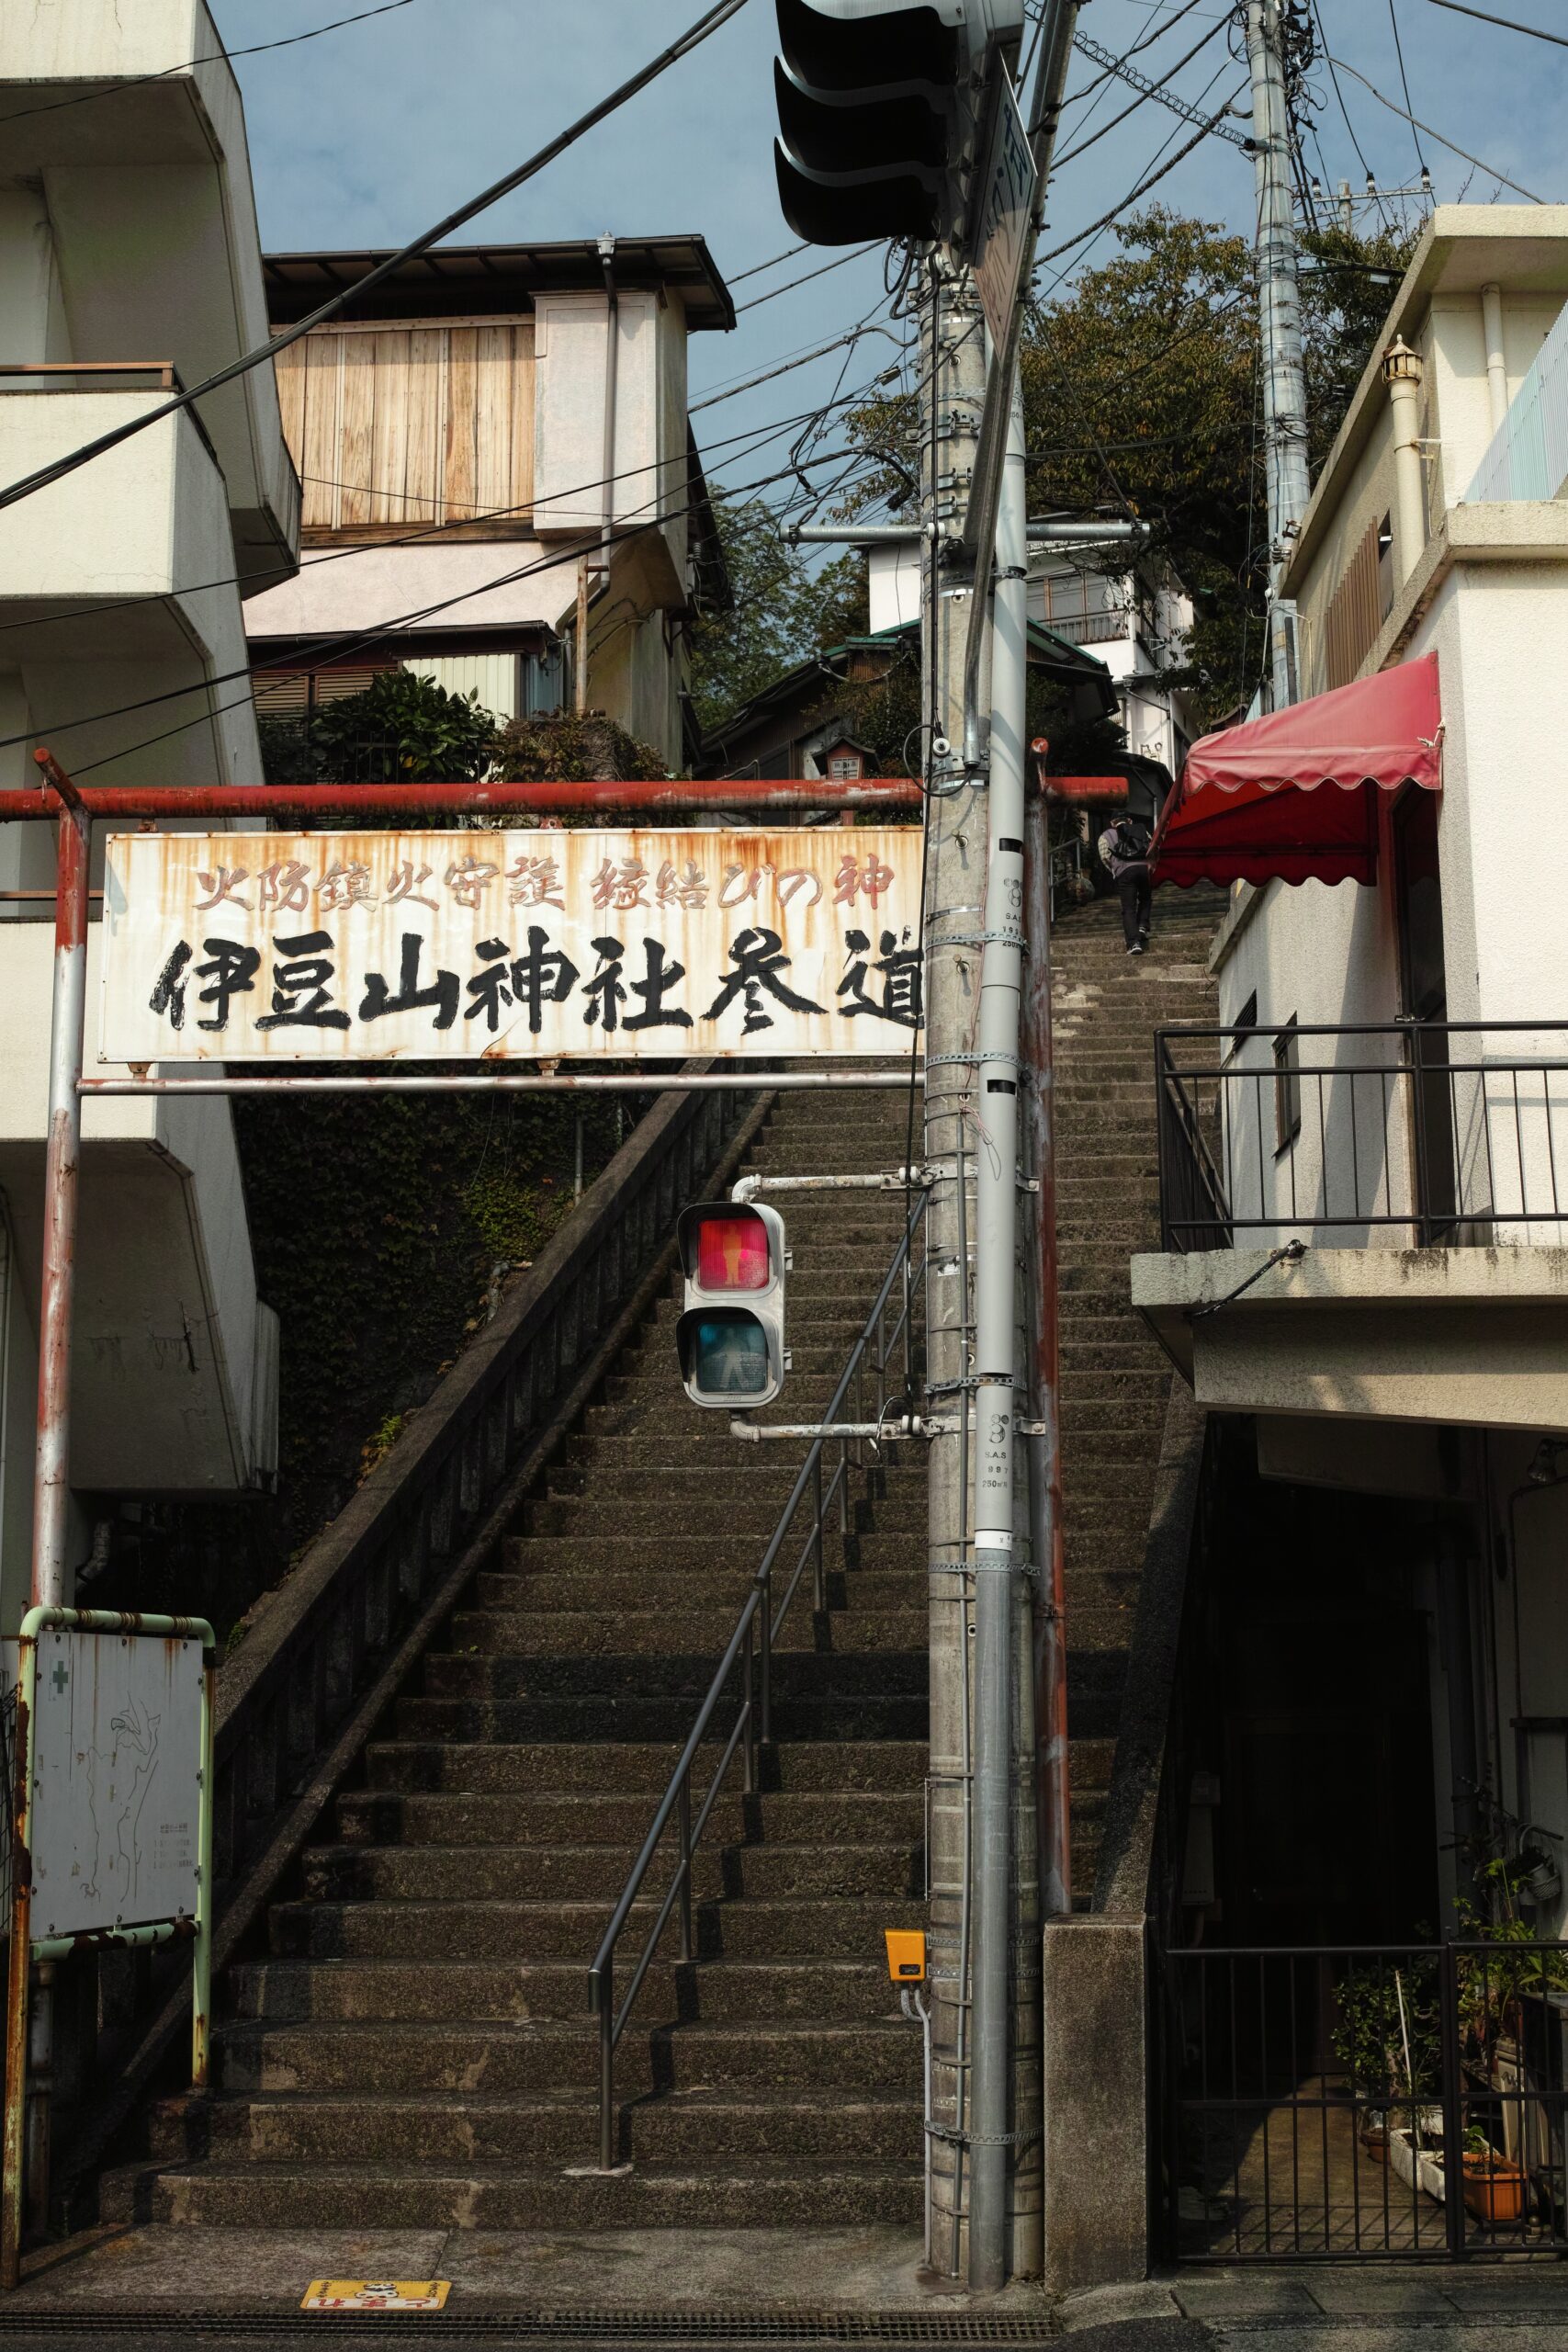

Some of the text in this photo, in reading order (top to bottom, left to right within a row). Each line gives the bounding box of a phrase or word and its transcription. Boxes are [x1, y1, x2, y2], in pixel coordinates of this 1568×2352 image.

[194, 853, 896, 912] 火防鎮火守護 縁結びの神
[149, 926, 925, 1035] 伊豆山神社参道
